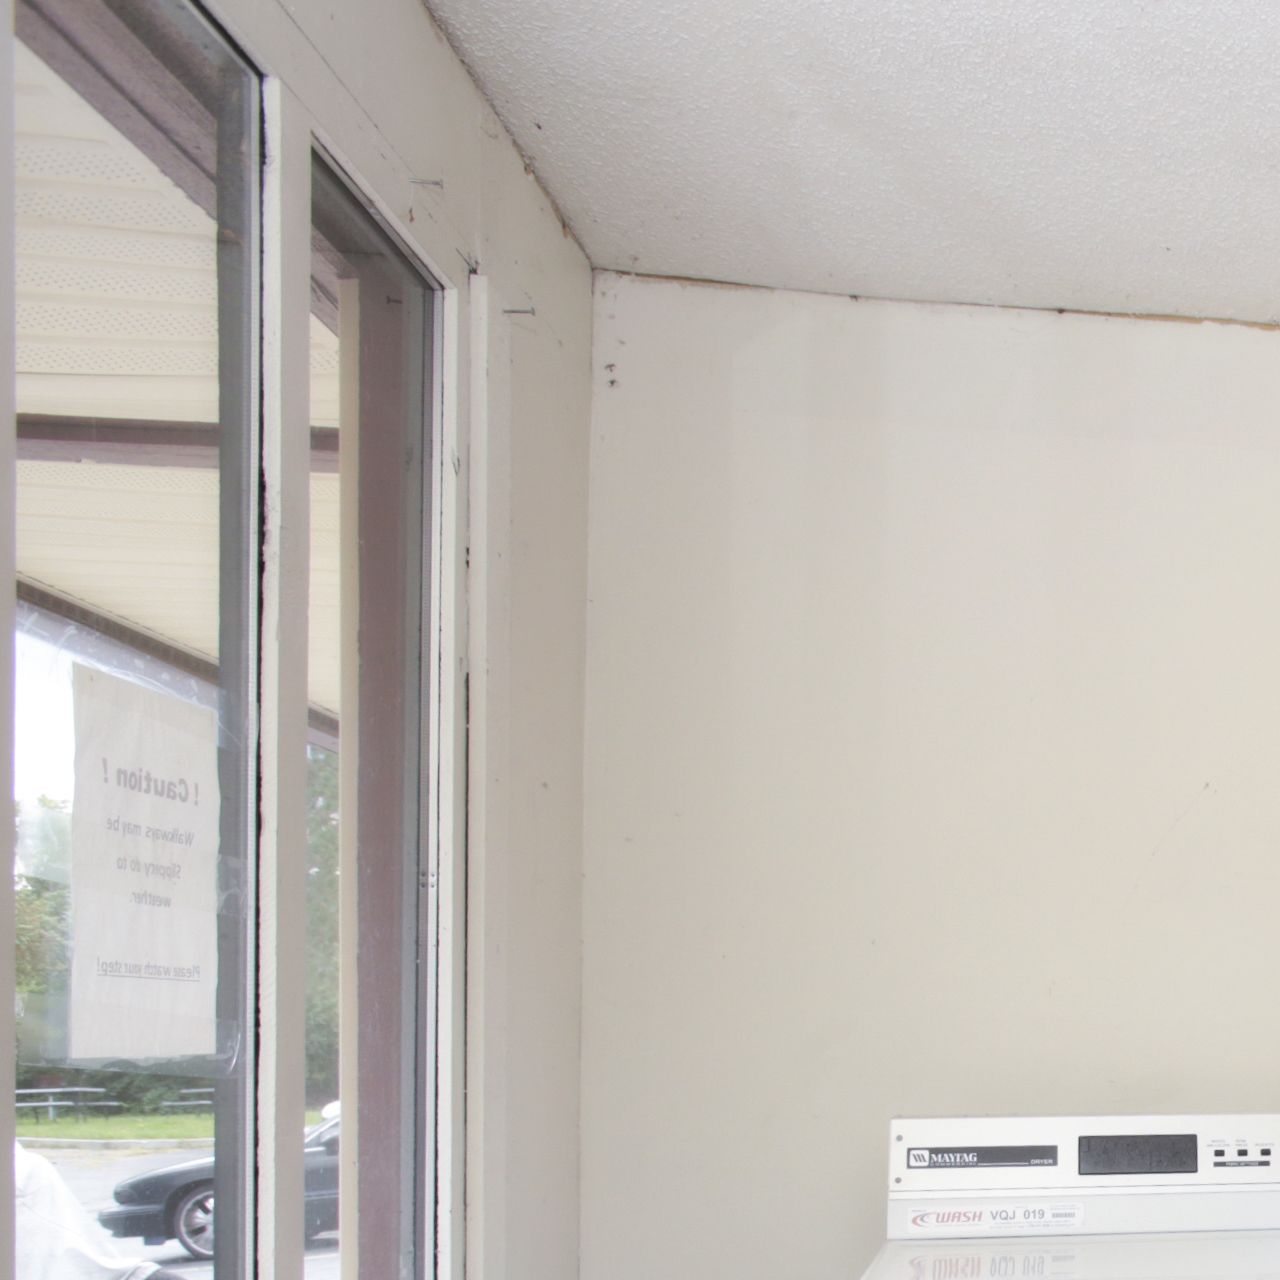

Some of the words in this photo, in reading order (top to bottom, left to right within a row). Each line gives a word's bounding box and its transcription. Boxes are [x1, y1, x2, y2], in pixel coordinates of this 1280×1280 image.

[930, 1152, 978, 1163] MAYTAG
[935, 1210, 984, 1223] WASH
[990, 1210, 1016, 1221] VQJ
[1023, 1209, 1045, 1219] 019
